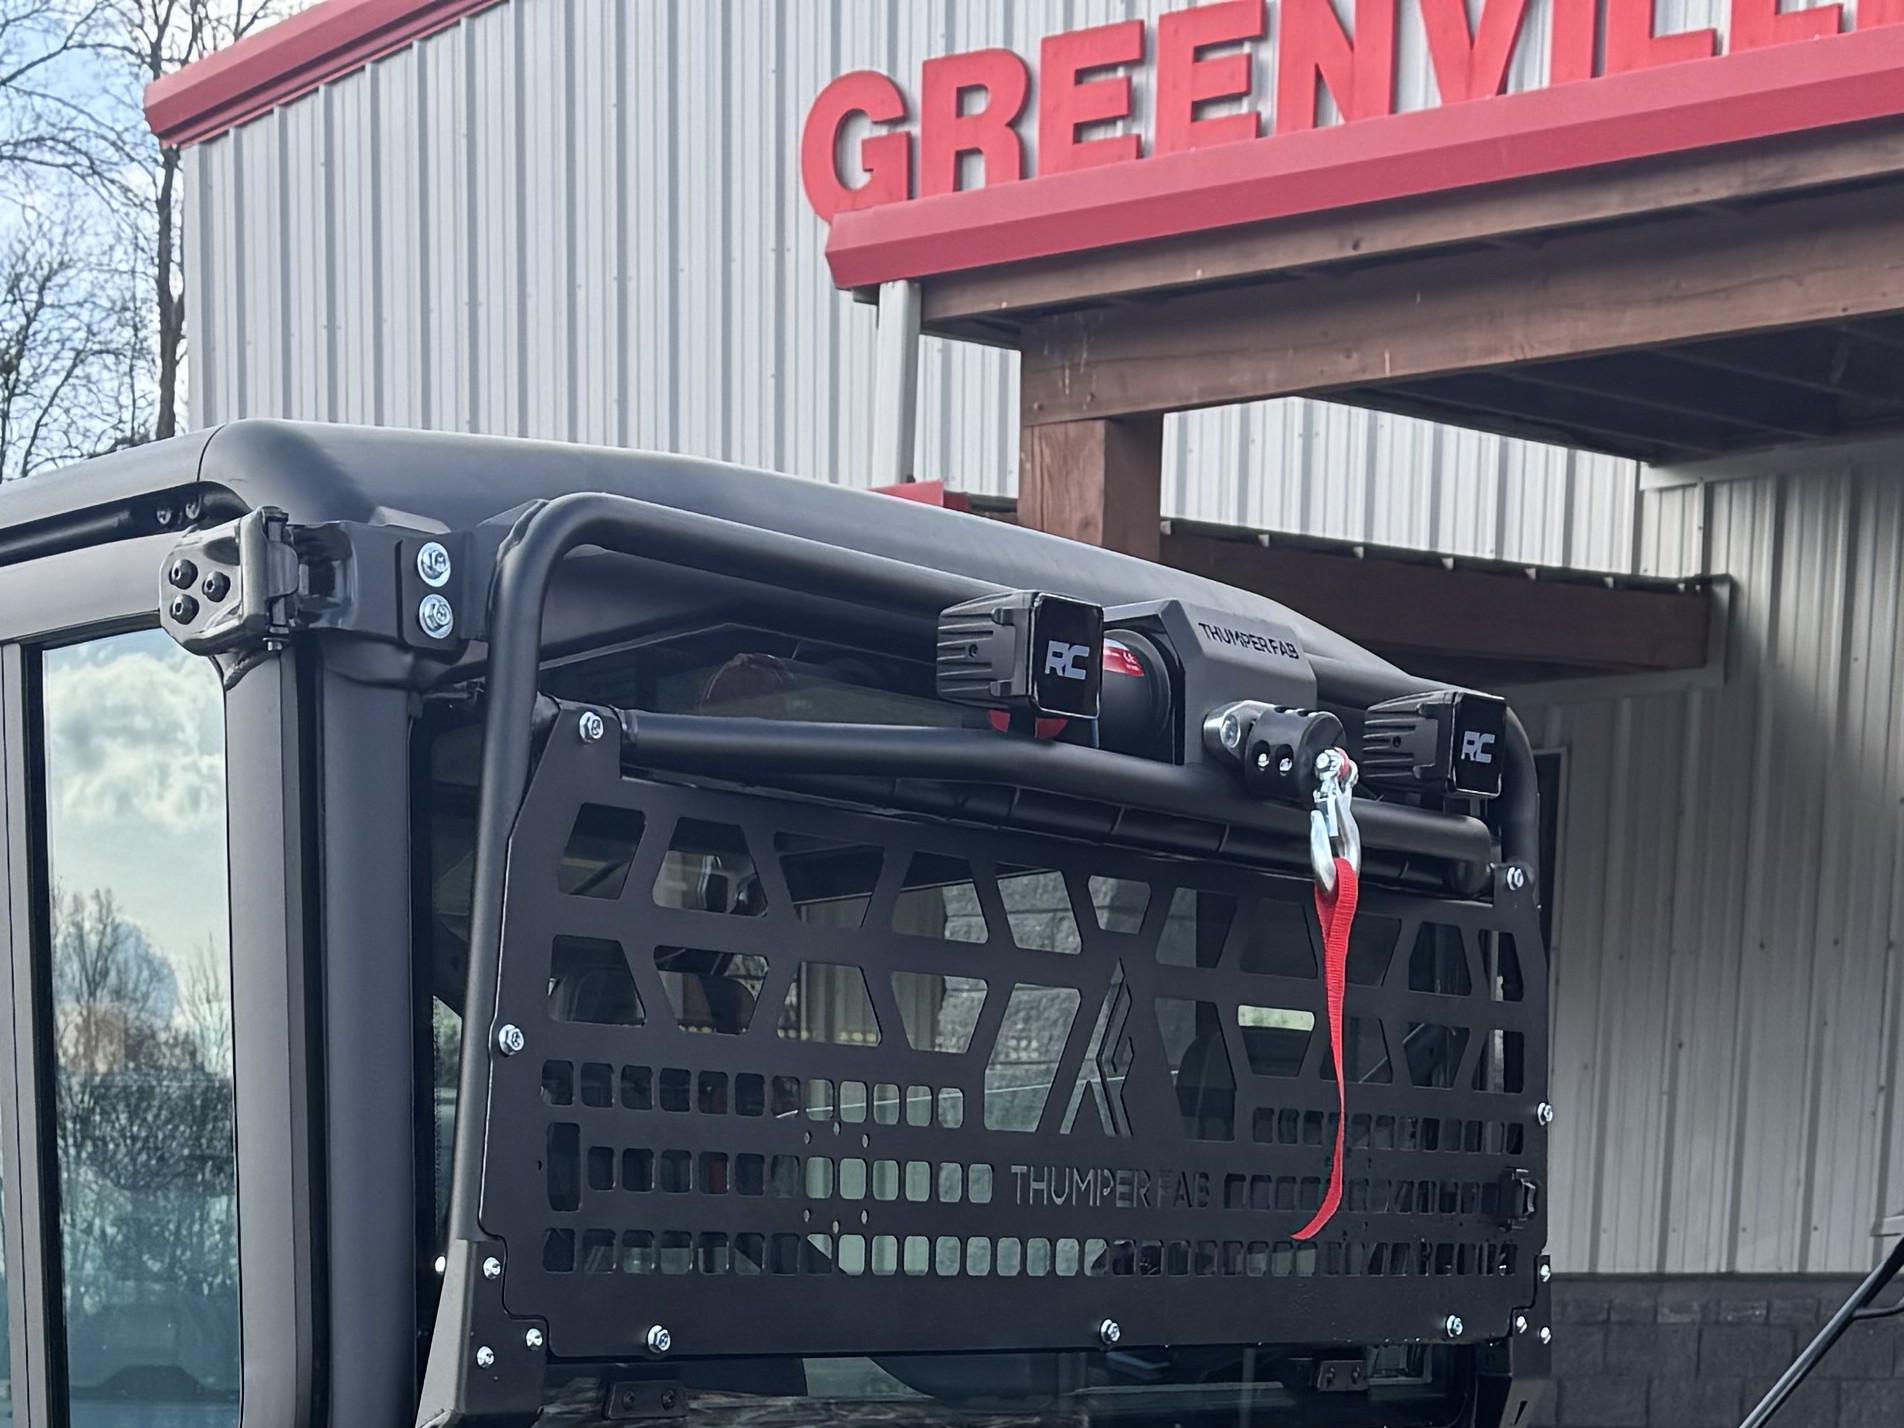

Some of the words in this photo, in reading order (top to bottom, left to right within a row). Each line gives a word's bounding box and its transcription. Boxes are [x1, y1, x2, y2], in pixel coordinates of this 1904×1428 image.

[1045, 639, 1090, 680] RC
[1198, 621, 1270, 655] THUMPER
[1269, 641, 1300, 660] FAB
[1460, 730, 1496, 763] RC
[1010, 1164, 1152, 1208] THUMPER
[1154, 1167, 1212, 1209] FAB
